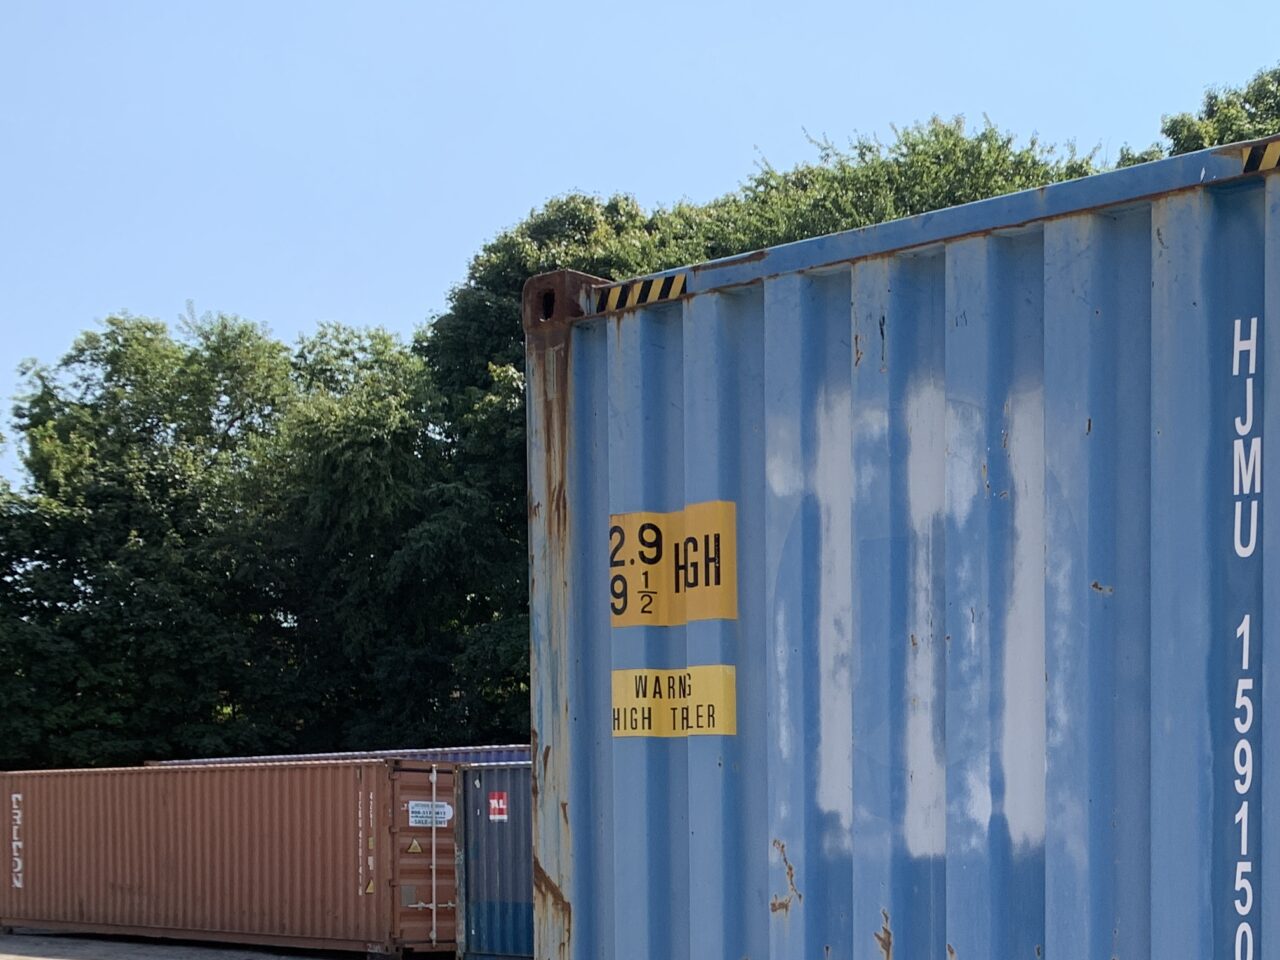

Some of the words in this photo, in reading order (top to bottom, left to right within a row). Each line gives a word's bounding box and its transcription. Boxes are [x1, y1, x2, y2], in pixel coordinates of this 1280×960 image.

[1232, 317, 1262, 557] HJMU
[609, 522, 663, 567] 2.9
[612, 707, 652, 731] HIGH
